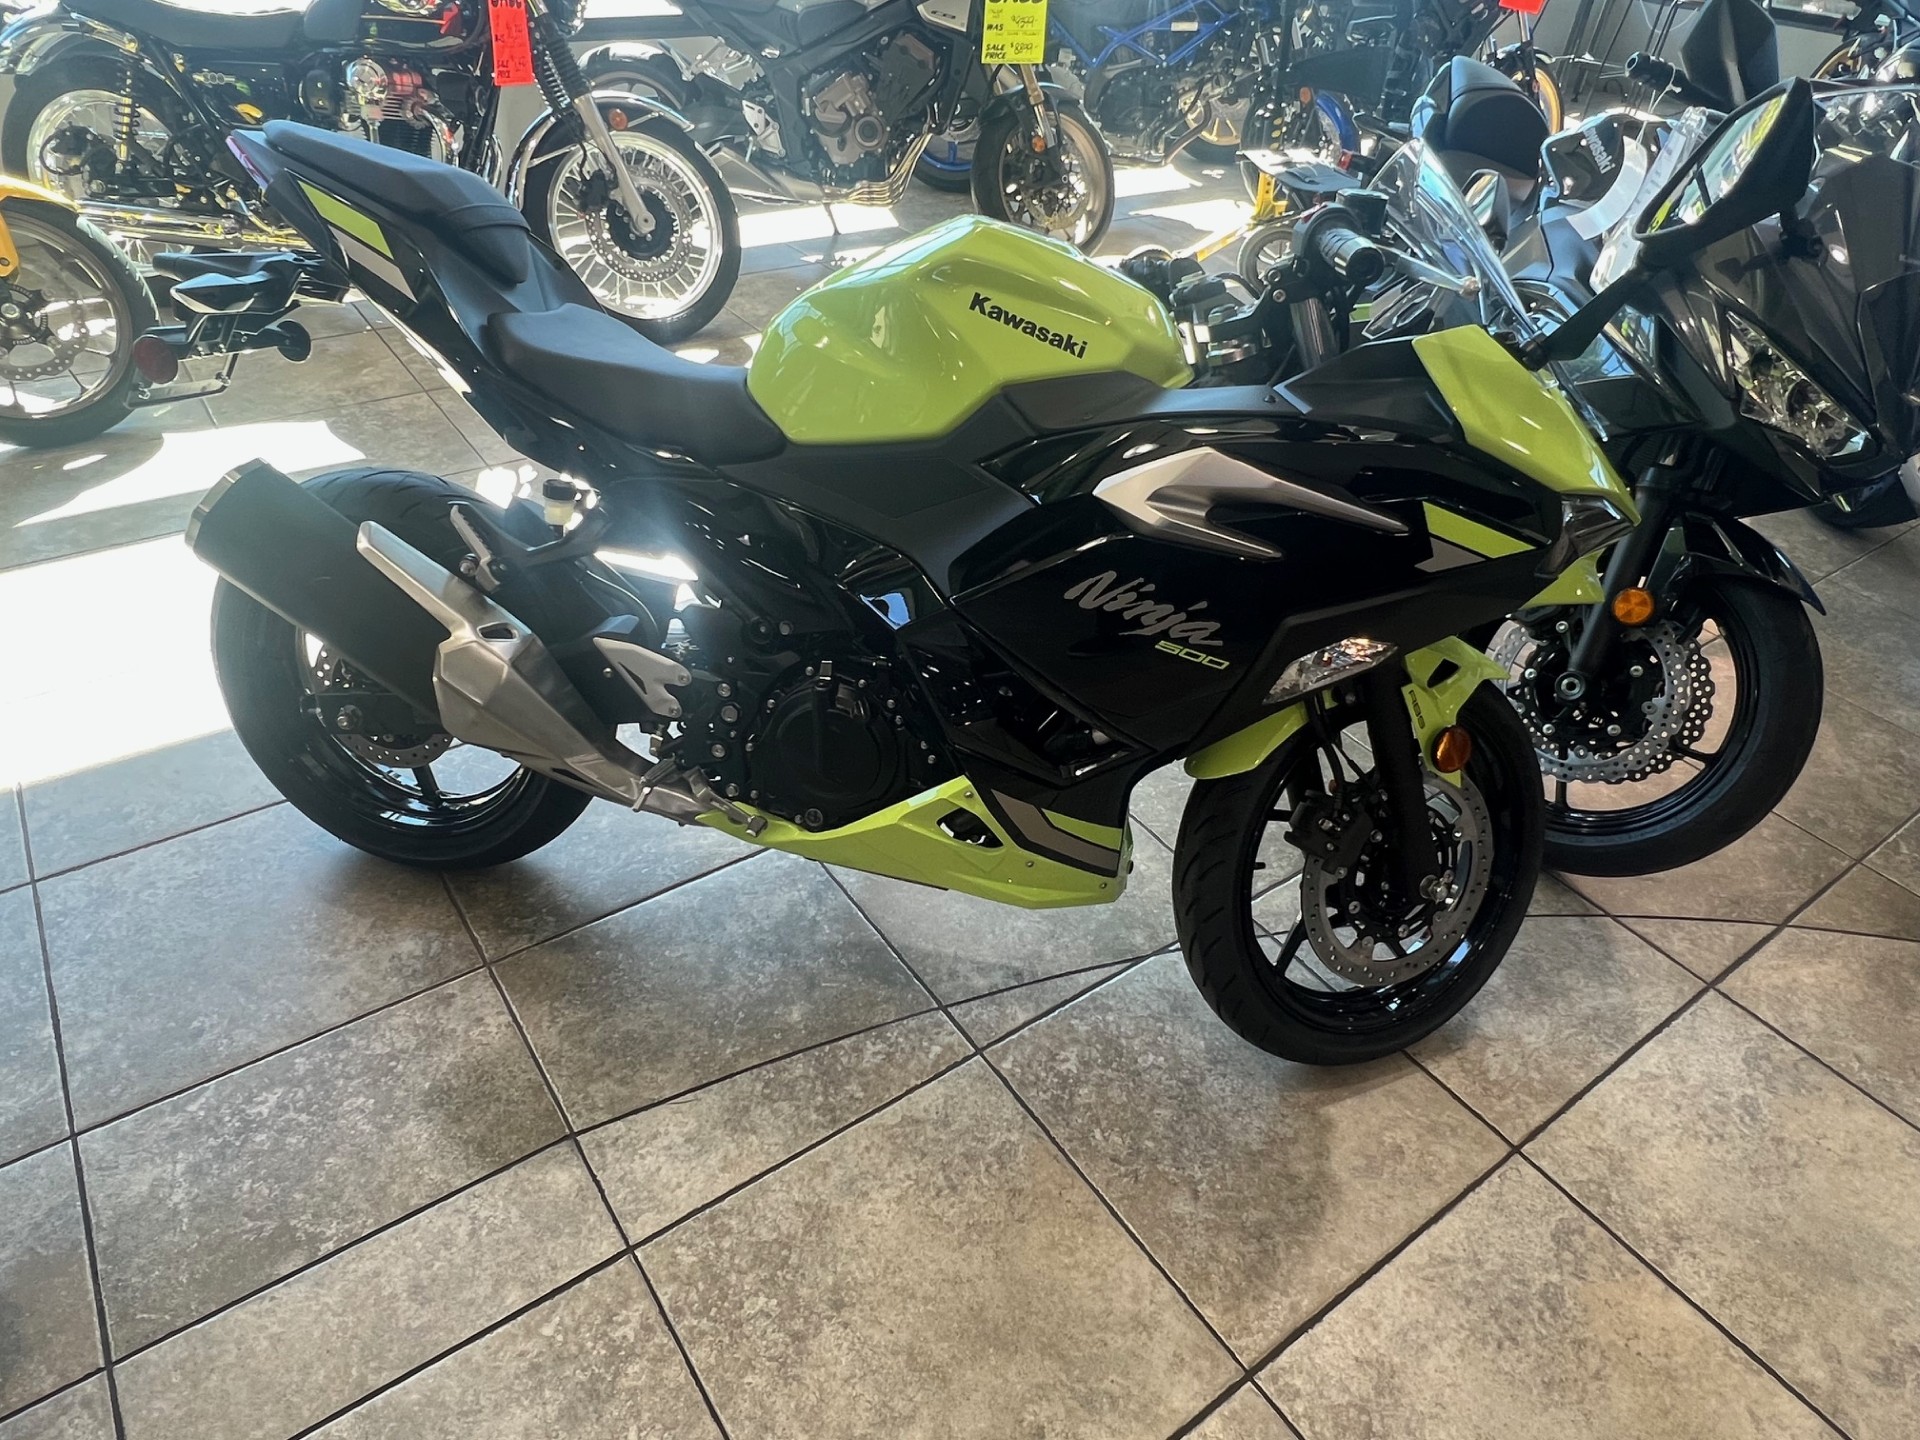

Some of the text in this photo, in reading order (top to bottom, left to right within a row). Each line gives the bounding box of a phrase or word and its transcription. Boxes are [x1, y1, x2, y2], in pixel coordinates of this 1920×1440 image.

[987, 23, 1004, 31] WAS
[984, 51, 1007, 60] PRICE
[985, 43, 1005, 51] SALE
[969, 292, 1088, 359] Kawasaki
[1064, 570, 1223, 646] Ninja
[1155, 640, 1230, 670] 500
[1408, 689, 1425, 729] ABS
